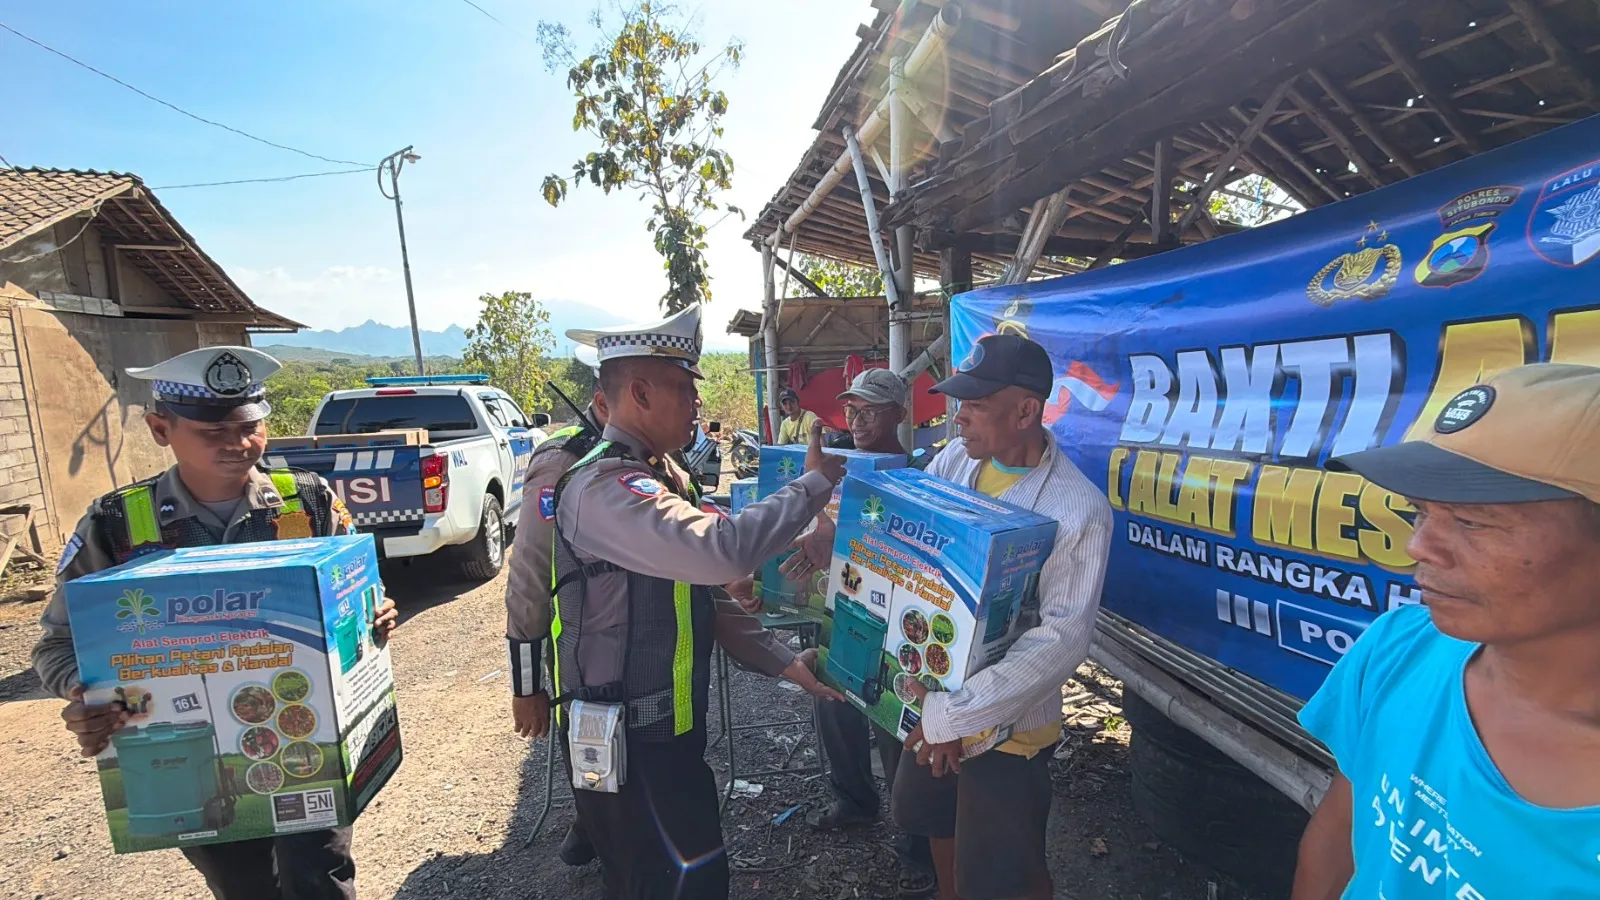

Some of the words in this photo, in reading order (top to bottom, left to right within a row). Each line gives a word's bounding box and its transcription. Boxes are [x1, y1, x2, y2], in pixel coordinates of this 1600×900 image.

[1552, 168, 1592, 191] LALU
[1447, 195, 1510, 217] SITUBONDO
[1457, 188, 1500, 206] POLRES
[1118, 332, 1393, 458] BAKTI
[1445, 407, 1473, 421] VANS
[451, 448, 468, 469] WAL
[886, 513, 951, 553] polar
[863, 533, 878, 547] Alat
[878, 541, 911, 563] Semprot
[911, 556, 943, 579] Elektrik
[1128, 522, 1207, 563] DALAM
[1216, 547, 1373, 607] RANGKA
[880, 554, 913, 579] Petani
[913, 572, 955, 600] Andalan
[165, 588, 265, 624] polar
[914, 583, 952, 611] Handal
[131, 639, 159, 650] Alat
[162, 635, 216, 648] Semprot
[219, 629, 270, 643] Elektrik
[111, 652, 166, 669] Pilihan
[170, 646, 225, 663] Petani
[229, 642, 294, 657] Andalan
[118, 662, 218, 681] Berkualitas
[222, 660, 234, 672] &
[238, 654, 293, 671] Handal
[174, 697, 190, 711] 16
[190, 695, 200, 708] L
[307, 793, 334, 810] SNI
[1410, 773, 1447, 805] WHERE
[1446, 821, 1482, 857] ATION
